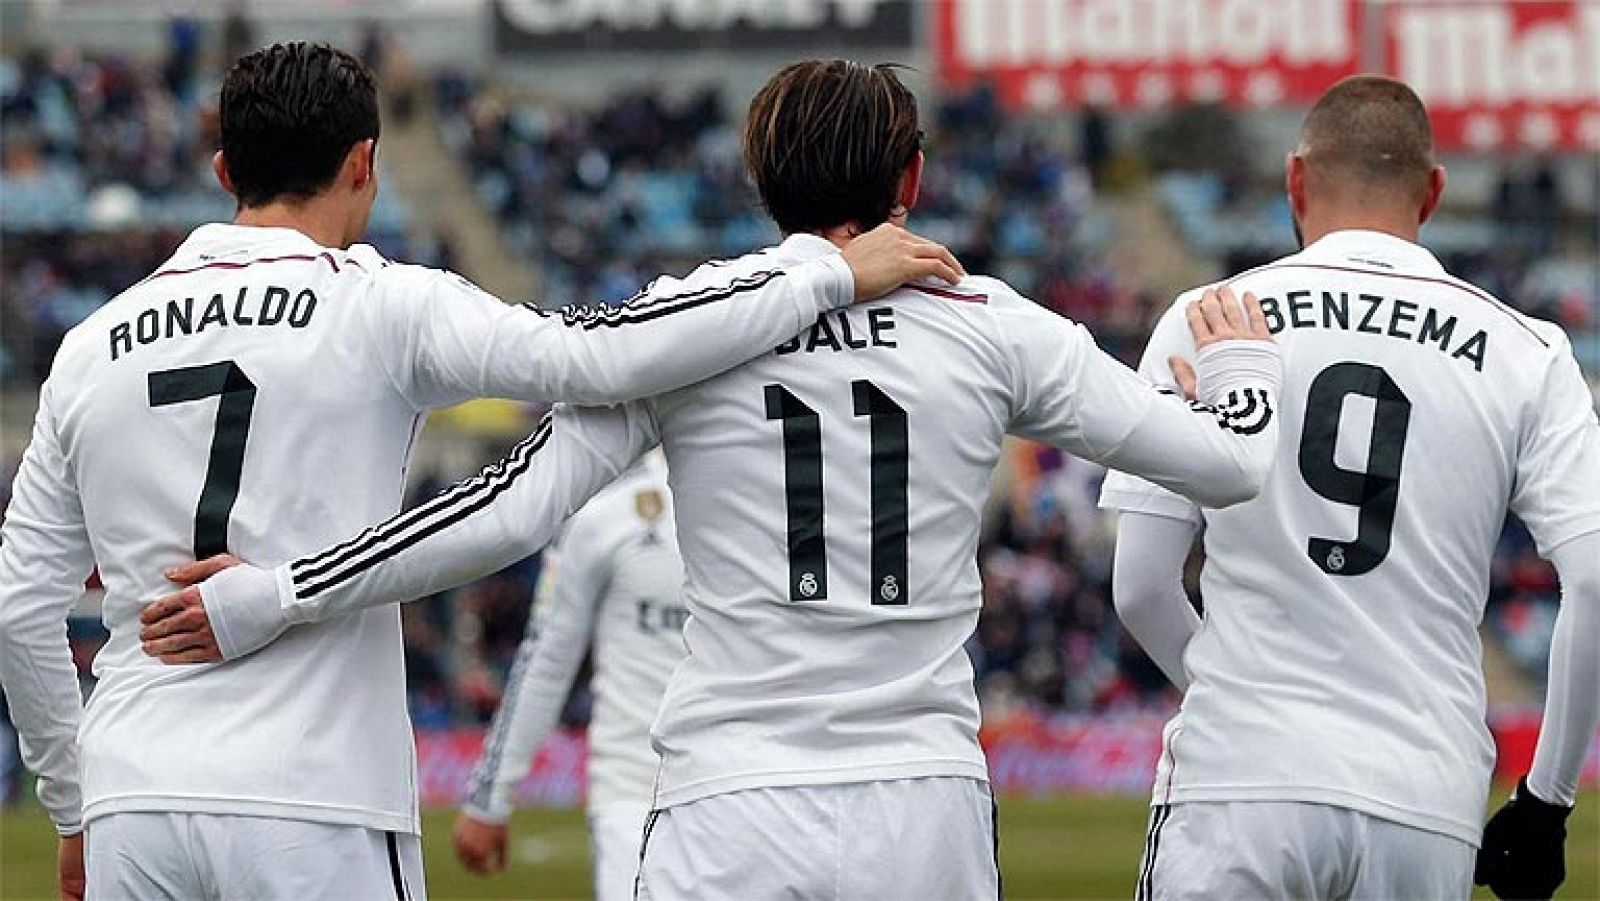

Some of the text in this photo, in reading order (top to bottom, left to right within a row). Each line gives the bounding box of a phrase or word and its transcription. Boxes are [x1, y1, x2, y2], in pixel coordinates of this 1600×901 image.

[109, 285, 317, 361] RONALDO
[774, 306, 897, 355] ALE
[1259, 290, 1488, 372] BENZEMA
[147, 360, 257, 562] 7
[764, 379, 909, 605] 11
[1298, 360, 1412, 576] 9
